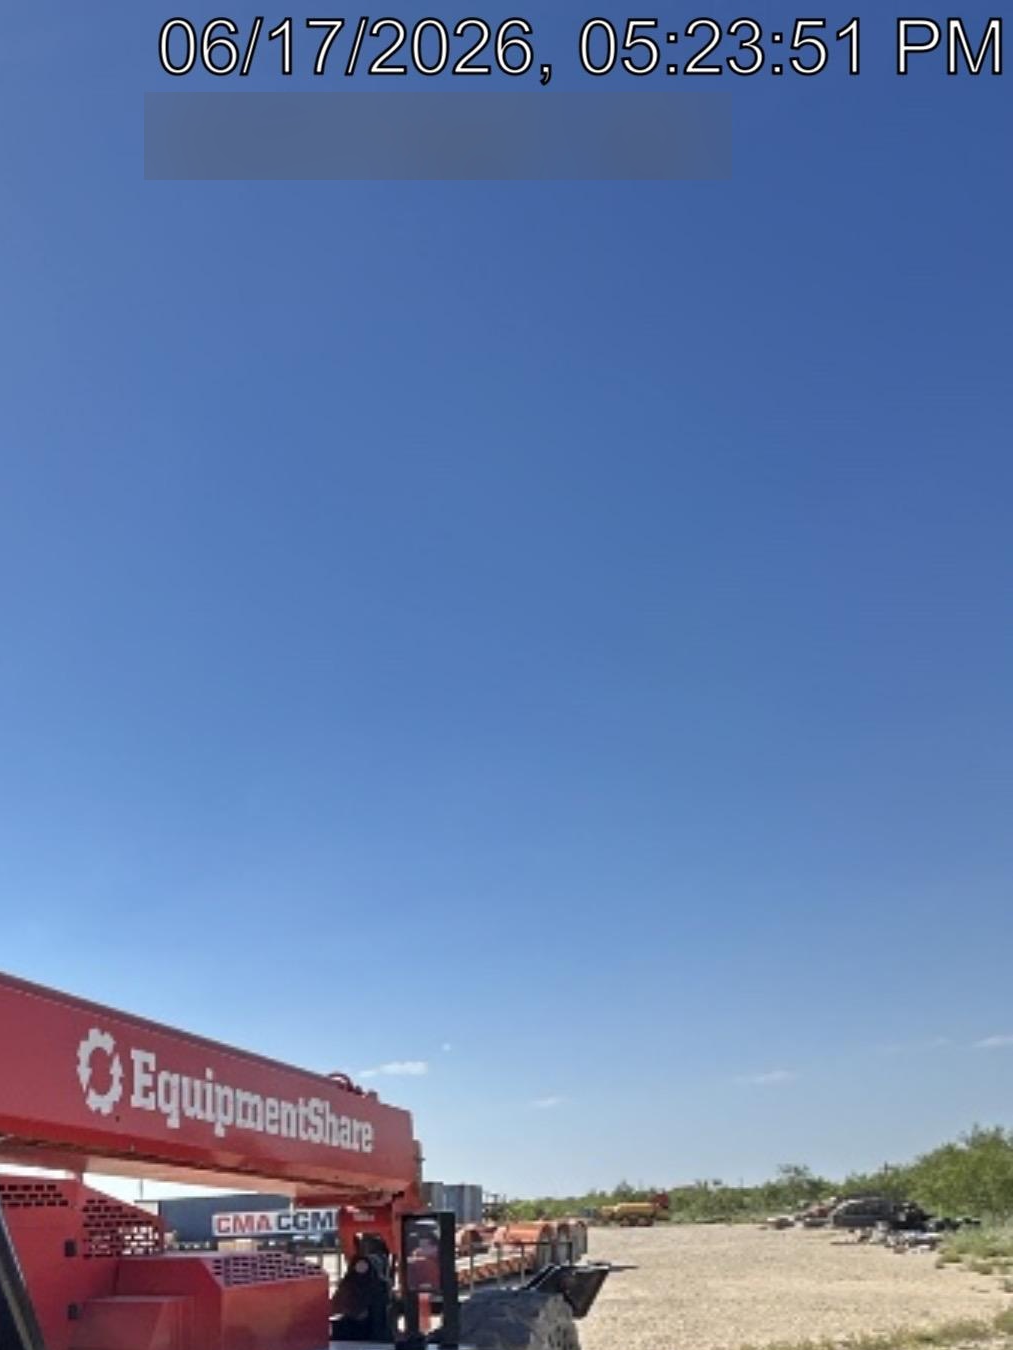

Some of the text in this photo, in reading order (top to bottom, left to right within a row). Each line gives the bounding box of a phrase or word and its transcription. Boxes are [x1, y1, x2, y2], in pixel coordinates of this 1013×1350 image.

[131, 1048, 374, 1152] EquipmentShare
[217, 1210, 334, 1233] CMA CGM
